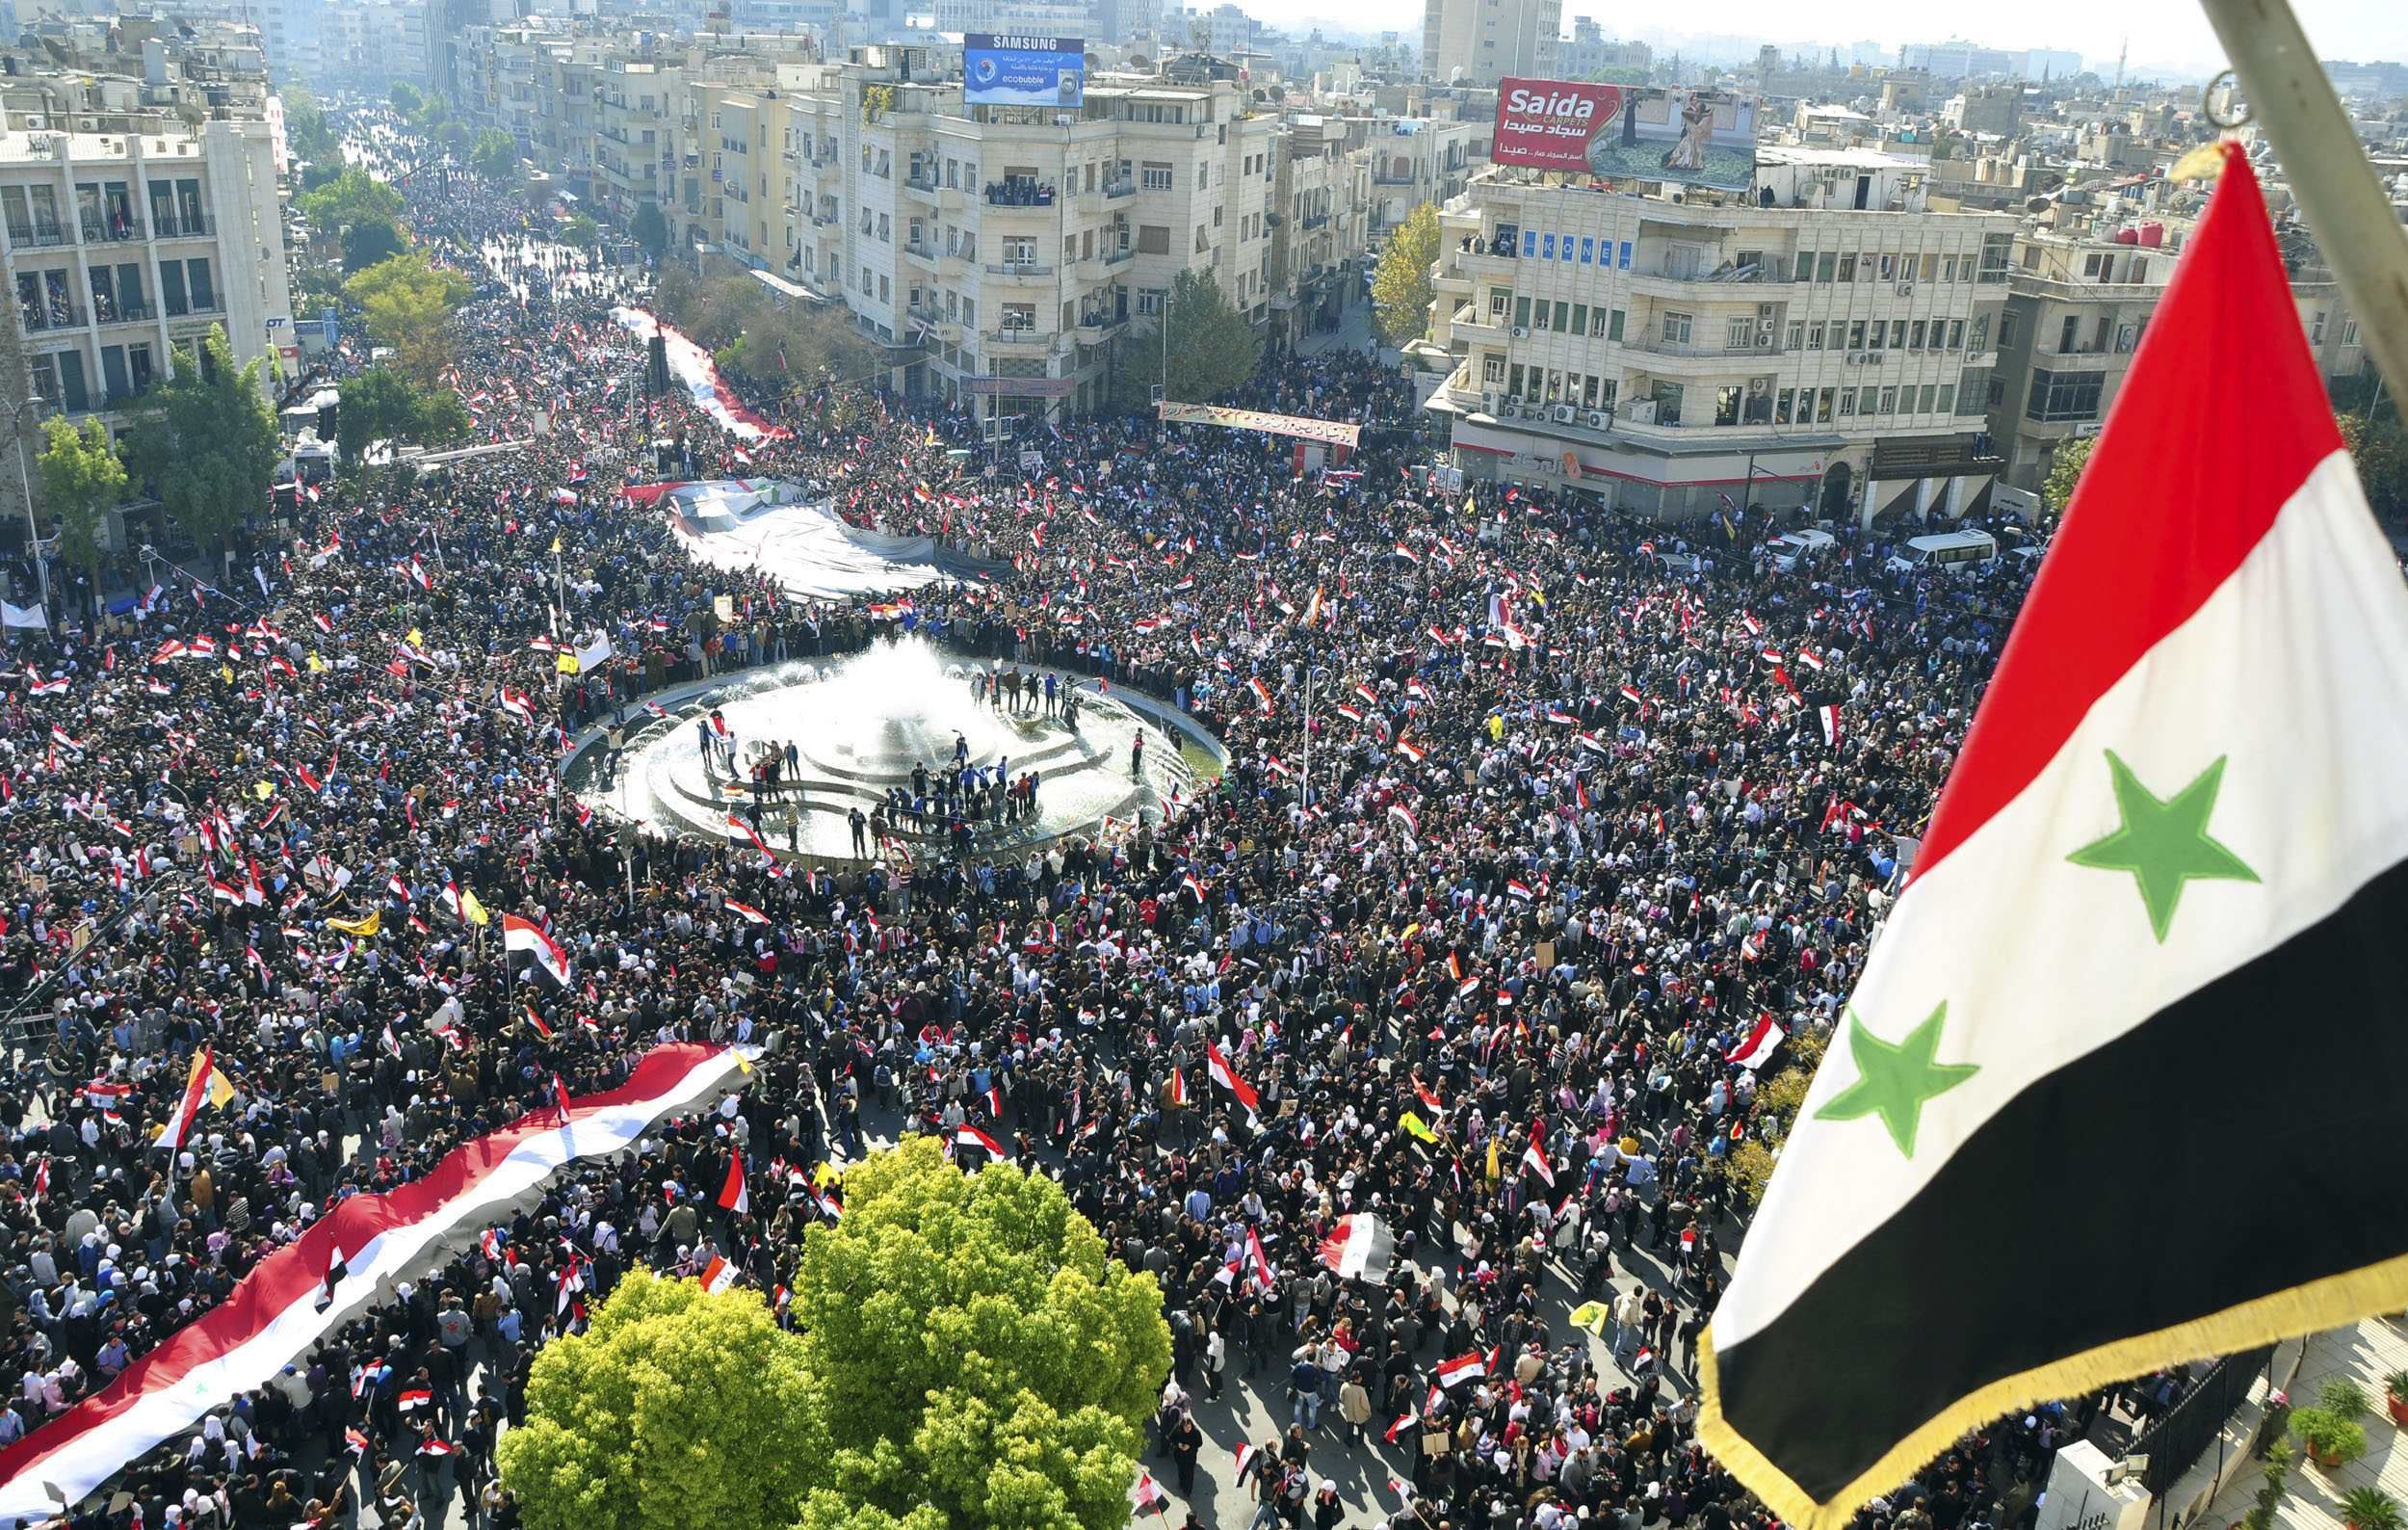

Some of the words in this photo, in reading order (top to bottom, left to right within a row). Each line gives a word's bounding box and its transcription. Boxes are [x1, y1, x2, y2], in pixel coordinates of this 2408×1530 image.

[994, 36, 1057, 50] SAMSUNG
[487, 57, 498, 101] HOTEL
[1002, 74, 1045, 84] ecobubble
[1506, 89, 1595, 119] Saida
[1503, 119, 1544, 134] صيدا
[1543, 116, 1589, 127] CARPETS
[1545, 124, 1586, 138] سجاد
[1499, 143, 1528, 156] صيدا
[1546, 150, 1568, 160] السجاد
[1544, 241, 1610, 259] KONE
